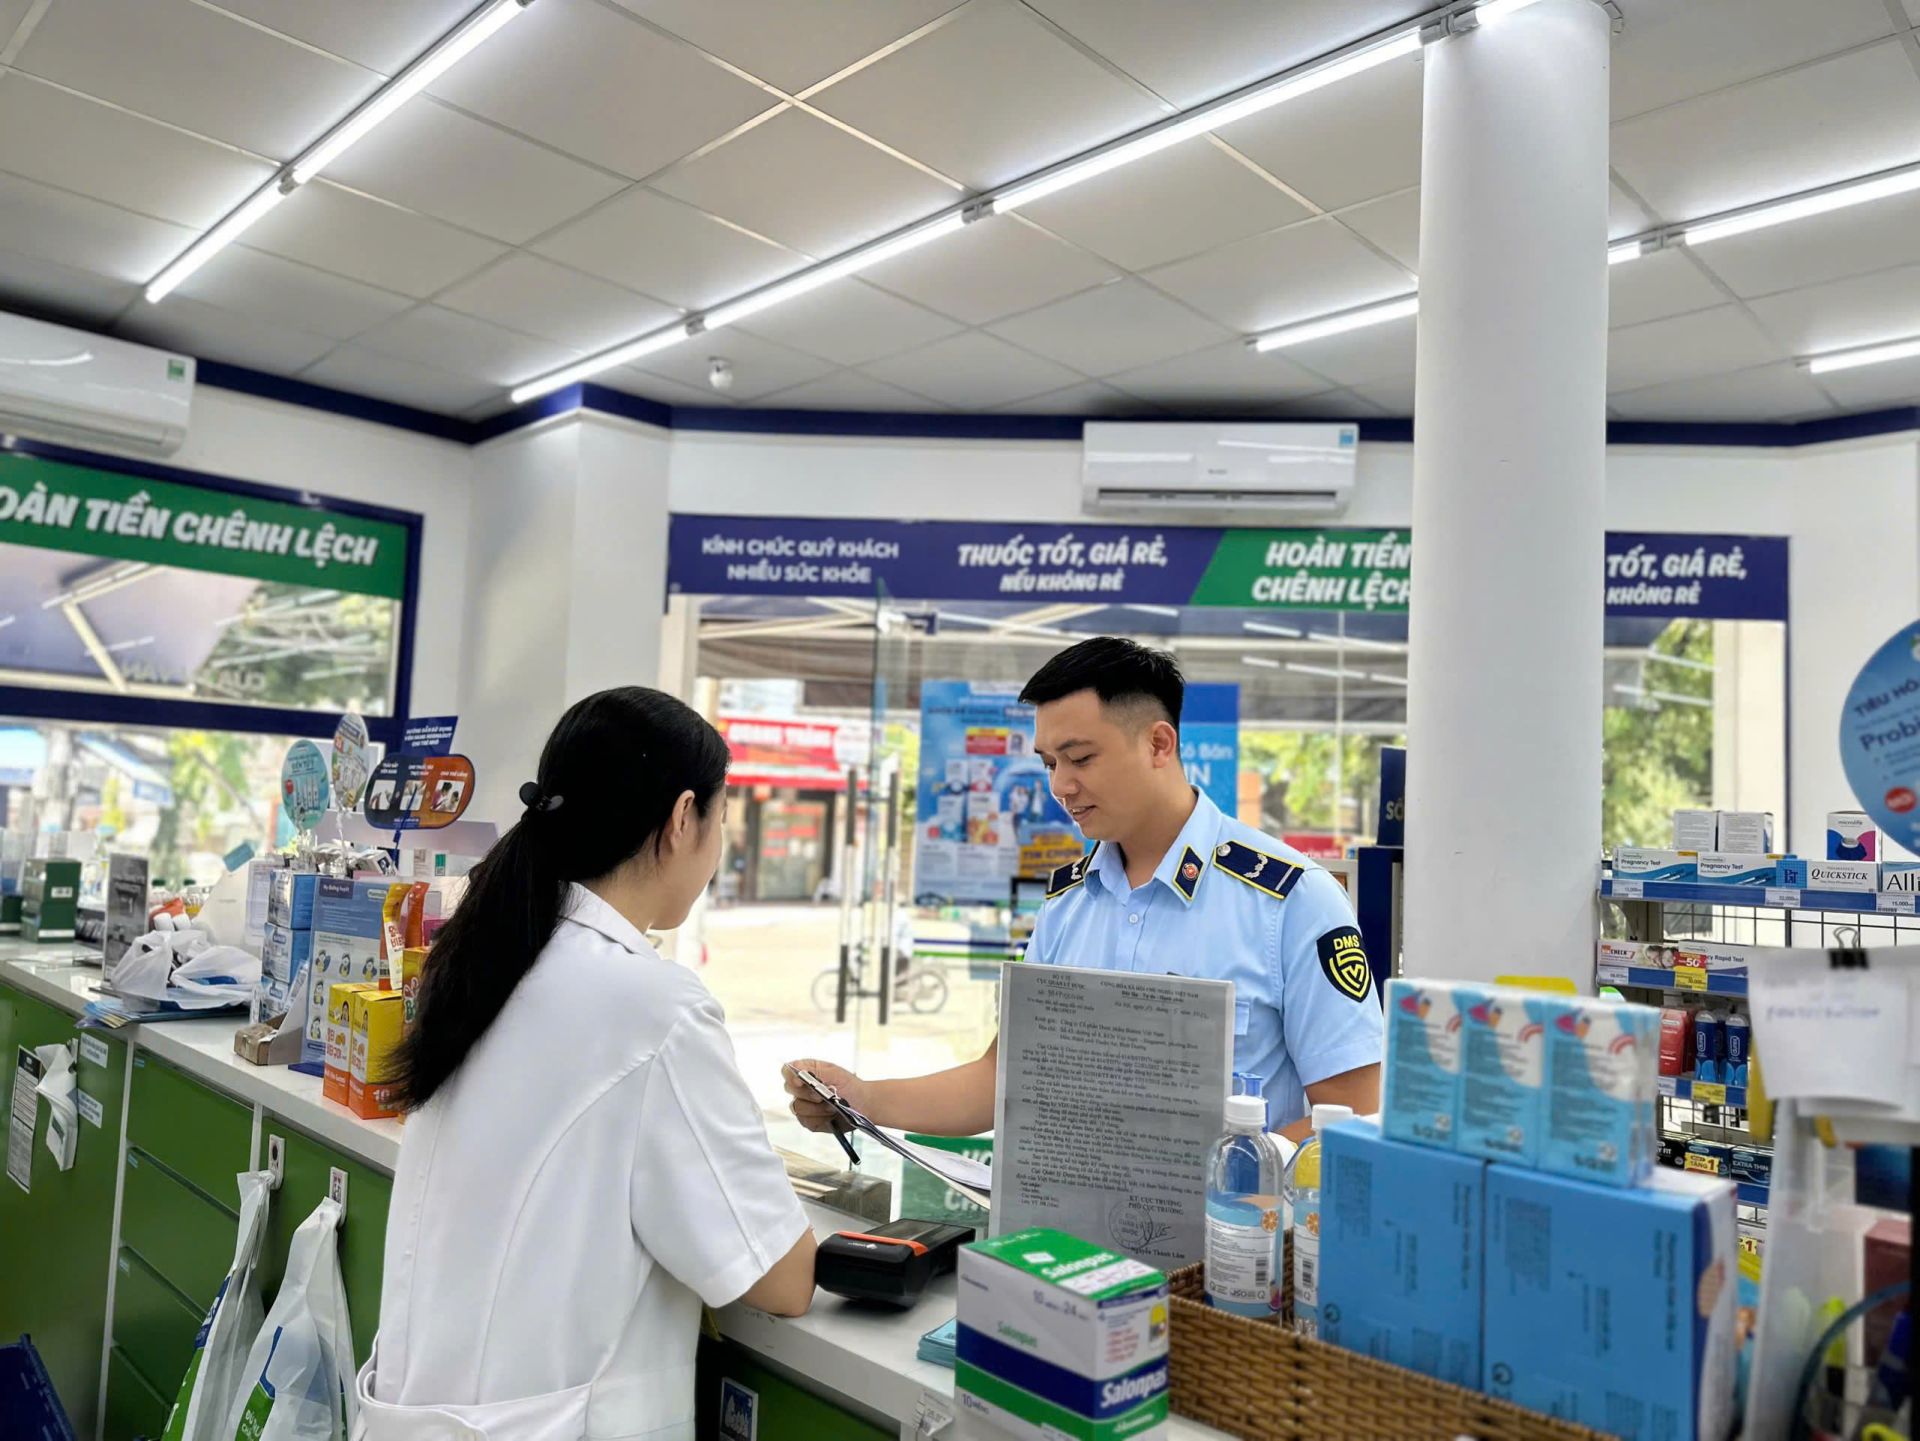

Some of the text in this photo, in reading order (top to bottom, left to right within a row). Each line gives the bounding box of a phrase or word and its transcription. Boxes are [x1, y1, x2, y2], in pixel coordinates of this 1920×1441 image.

[172, 509, 294, 556] CHÊNH
[293, 522, 379, 568] LỆCH
[702, 534, 743, 554] KÍNH
[746, 535, 795, 556] CHÚC
[838, 538, 900, 559] KHÁCH
[958, 532, 1168, 568] THUỐC TỐT, GIÁ RẺ,
[1265, 535, 1347, 567] HOÀN
[1607, 544, 1747, 580] TỐT, GIÁ RẺ,
[1000, 567, 1125, 592] NẾU KHÔNG RẺ
[1252, 569, 1347, 602] CHÊNH
[1606, 580, 1702, 605] KHÔNG RẺ
[1811, 868, 1868, 880] QUICKSTICK
[1333, 934, 1360, 950] DMS
[1715, 954, 1732, 962] Rapid
[1708, 1158, 1715, 1170] 1
[1732, 1160, 1769, 1172] EXTRA THIN
[1745, 1239, 1753, 1252] 1
[1041, 1251, 1115, 1279] Salonpas
